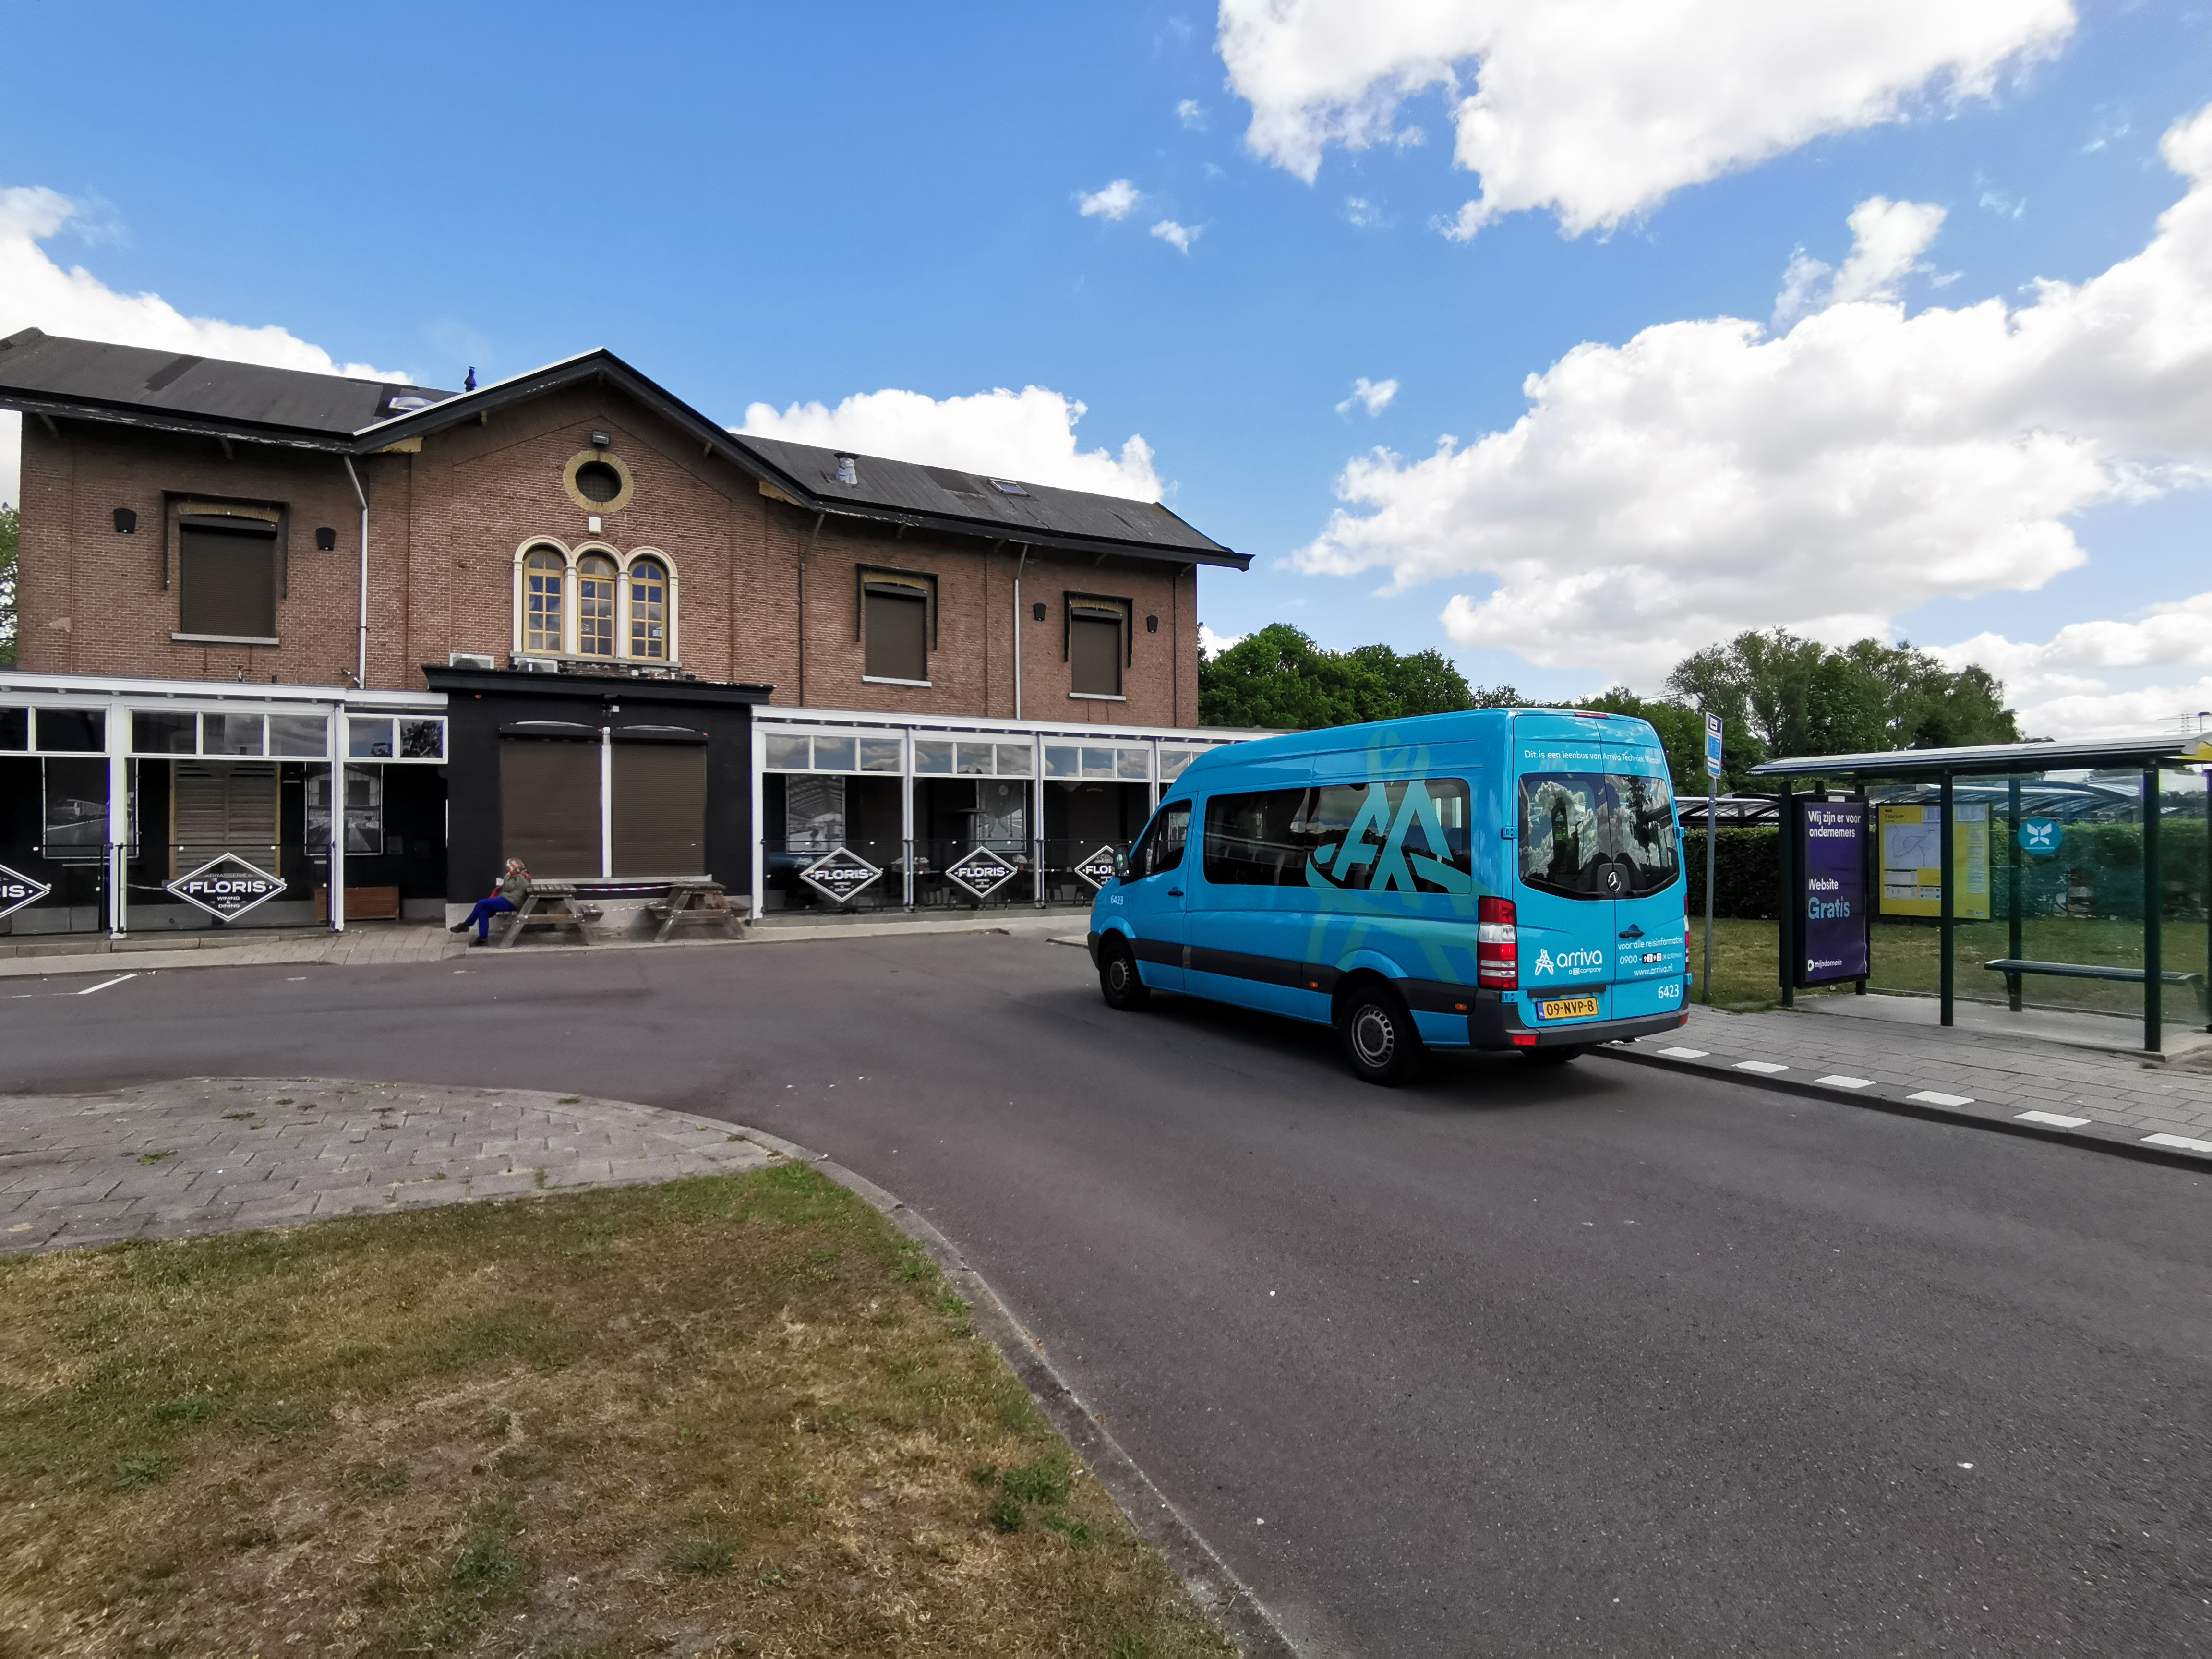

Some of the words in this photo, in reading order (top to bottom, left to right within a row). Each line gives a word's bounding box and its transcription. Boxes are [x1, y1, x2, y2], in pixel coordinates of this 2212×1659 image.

[1524, 750, 1537, 758] Dit
[1539, 750, 1545, 758] is
[1562, 750, 1588, 759] leenbus
[1603, 753, 1621, 761] Arriva
[1622, 754, 1644, 762] Techniek
[1808, 811, 1822, 825] Wij
[1823, 811, 1836, 825] zijn
[1837, 814, 1844, 823] er
[1845, 815, 1861, 823] voor
[1809, 825, 1855, 837] ondernemers
[815, 869, 869, 880] FLORIS
[958, 867, 1005, 877] FLORIS
[189, 881, 266, 893] FLORIS
[1808, 878, 1839, 890] Website
[1110, 895, 1123, 905] 6423
[1808, 895, 1850, 919] Gratis
[1633, 940, 1645, 949] alle
[1557, 948, 1602, 968] arriva
[1619, 955, 1638, 964] 0900
[1643, 953, 1662, 963] 9292
[1815, 959, 1842, 969] mijndomein
[1633, 963, 1673, 976] www.arriva.nl
[1658, 984, 1679, 999] 6423
[1546, 1000, 1594, 1016] 09-NVP-8
